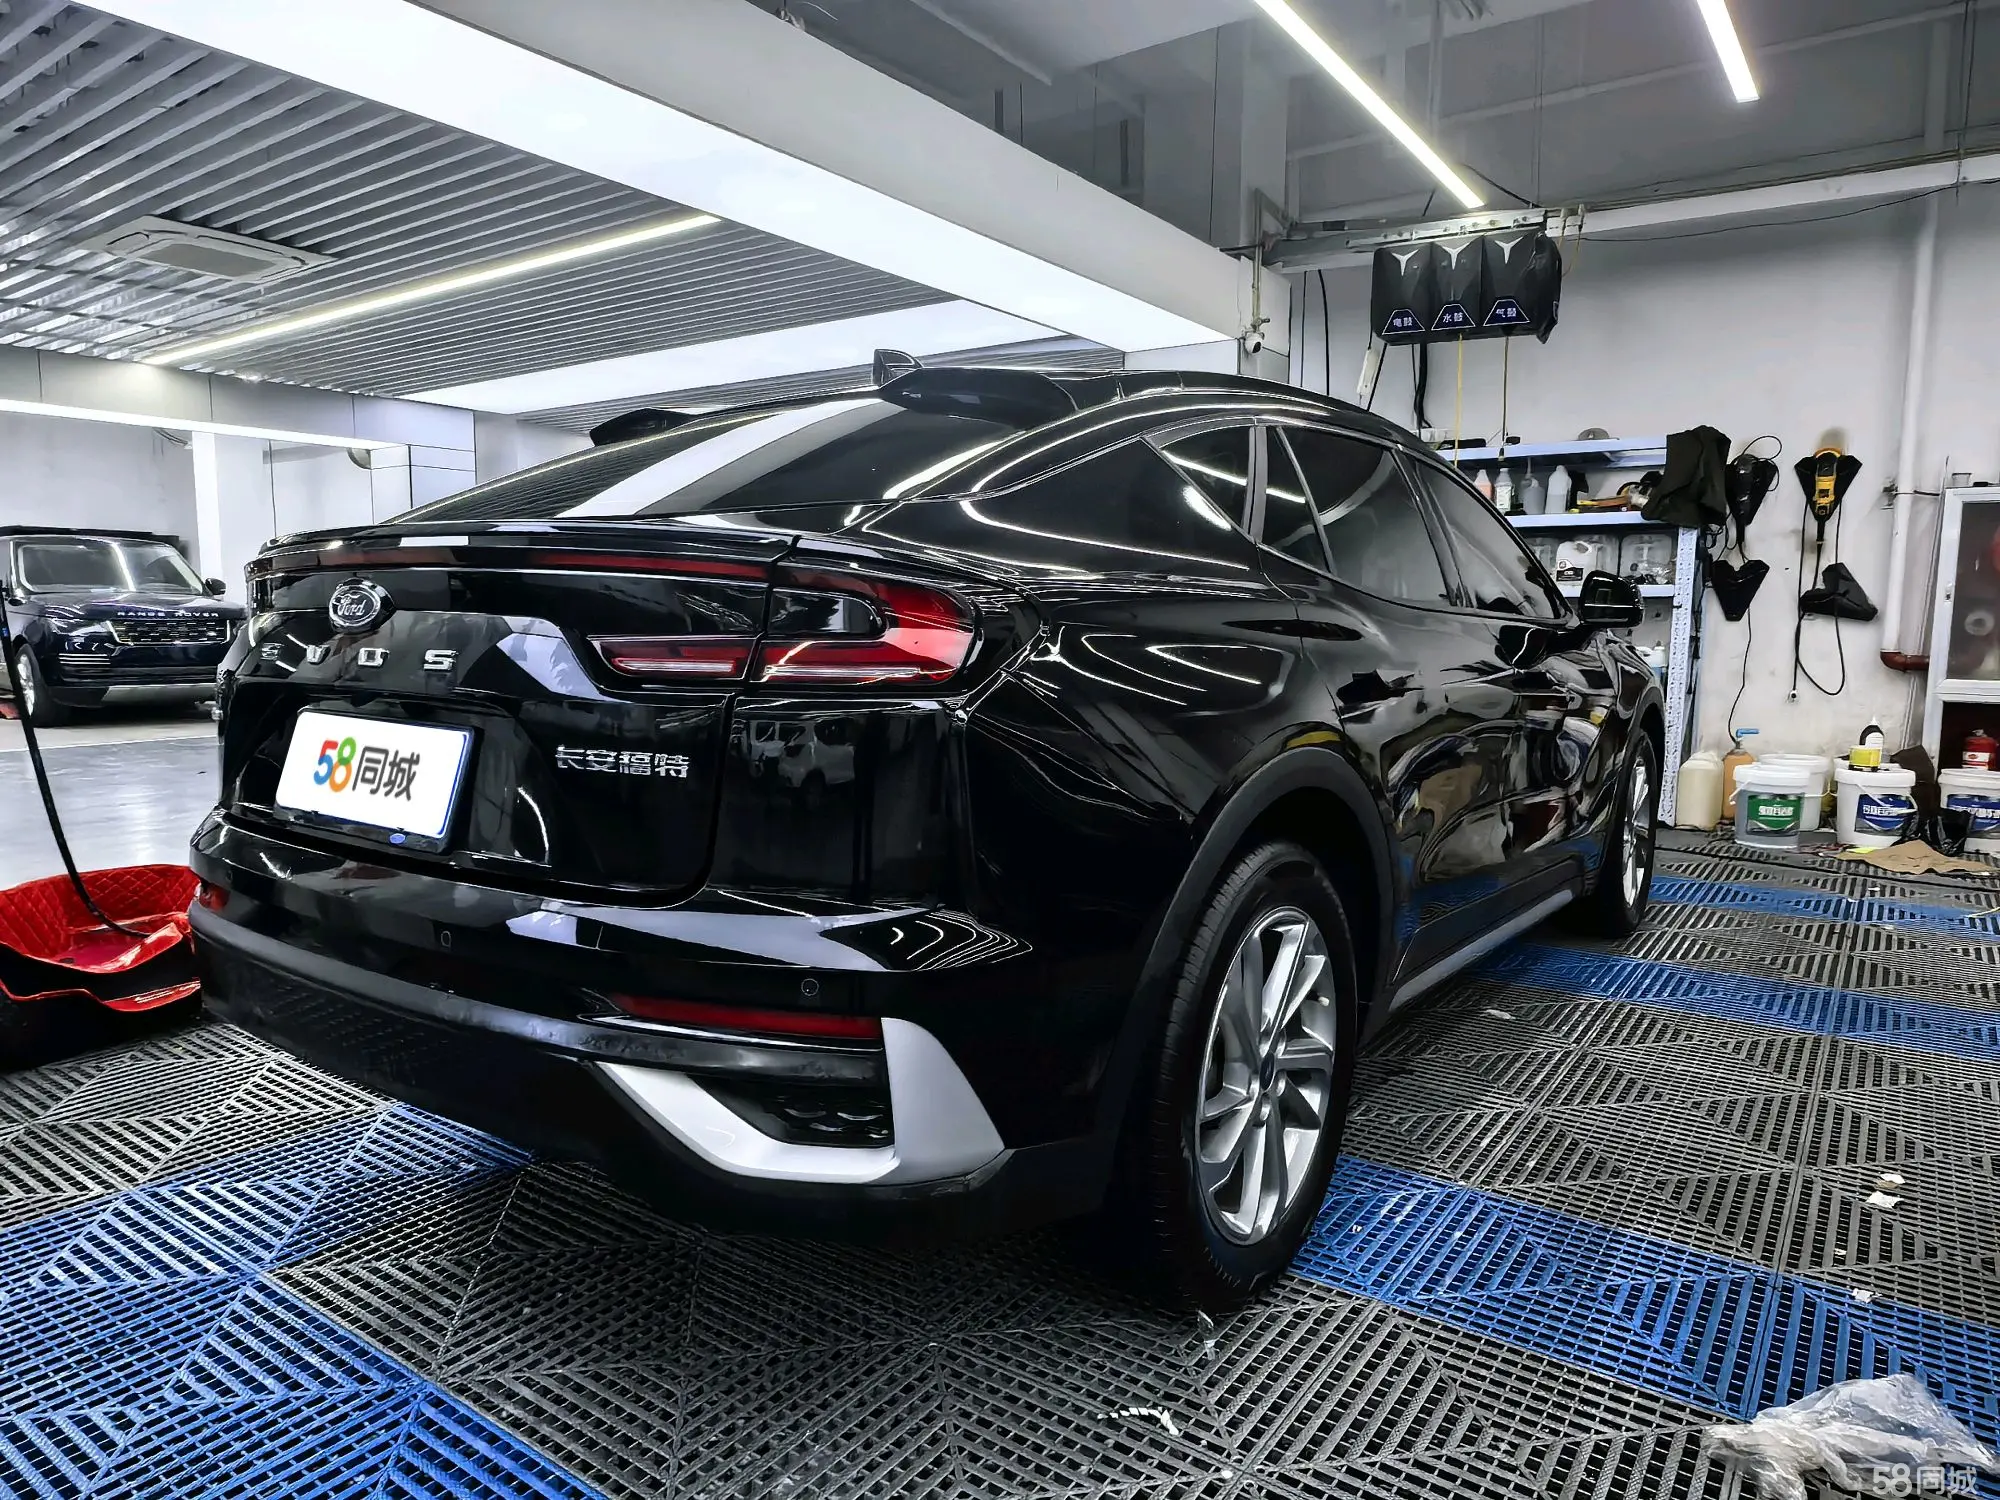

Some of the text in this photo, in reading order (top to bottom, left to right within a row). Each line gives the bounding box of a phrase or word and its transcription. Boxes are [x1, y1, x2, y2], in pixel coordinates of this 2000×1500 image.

[332, 594, 366, 617] Ford
[555, 744, 690, 779] 长安福特
